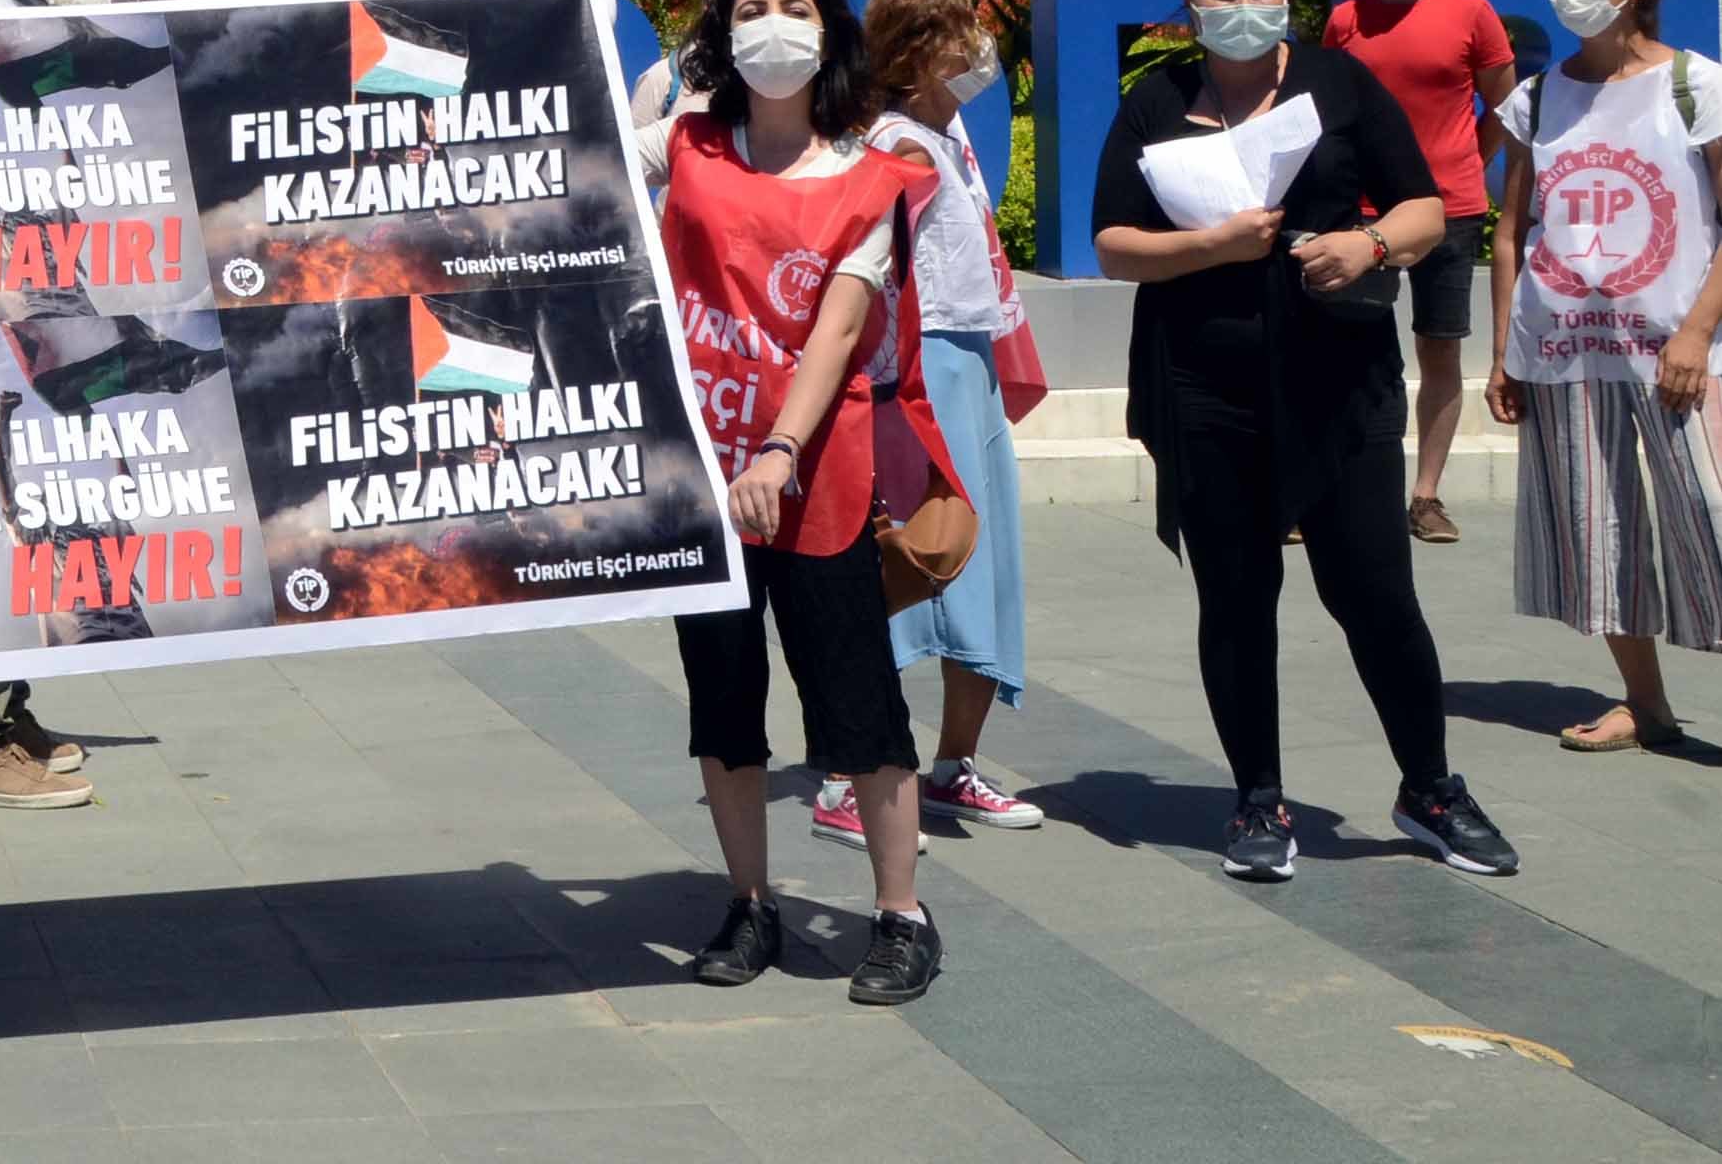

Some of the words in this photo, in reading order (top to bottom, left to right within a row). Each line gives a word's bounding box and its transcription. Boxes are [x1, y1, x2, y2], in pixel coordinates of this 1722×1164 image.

[230, 99, 418, 163] FİLİSTİN
[433, 85, 570, 145] HALKI
[264, 148, 568, 225] KAZANACAK!
[1582, 151, 1615, 166] İŞÇİ
[1559, 180, 1634, 225] TİP
[442, 254, 520, 276] TÜRKİYE
[520, 251, 556, 273] İŞÇİ
[558, 245, 626, 268] PARTİSİ
[791, 266, 821, 291] TİP
[678, 290, 803, 369] ÜRKİY
[1550, 309, 1647, 329] TÜRKİYE
[1538, 335, 1578, 361] İŞÇİ
[10, 408, 189, 465] İLHAKA
[290, 395, 486, 468] FİLİSTİN
[501, 381, 644, 444] HALKI
[14, 462, 236, 529] SÜRGÜNE
[327, 443, 644, 531] KAZANACAK!
[10, 524, 243, 616] HAYIR!
[514, 558, 594, 583] TÜRKİYE
[596, 553, 632, 579] İŞÇİ
[635, 546, 704, 572] PARTİSİ
